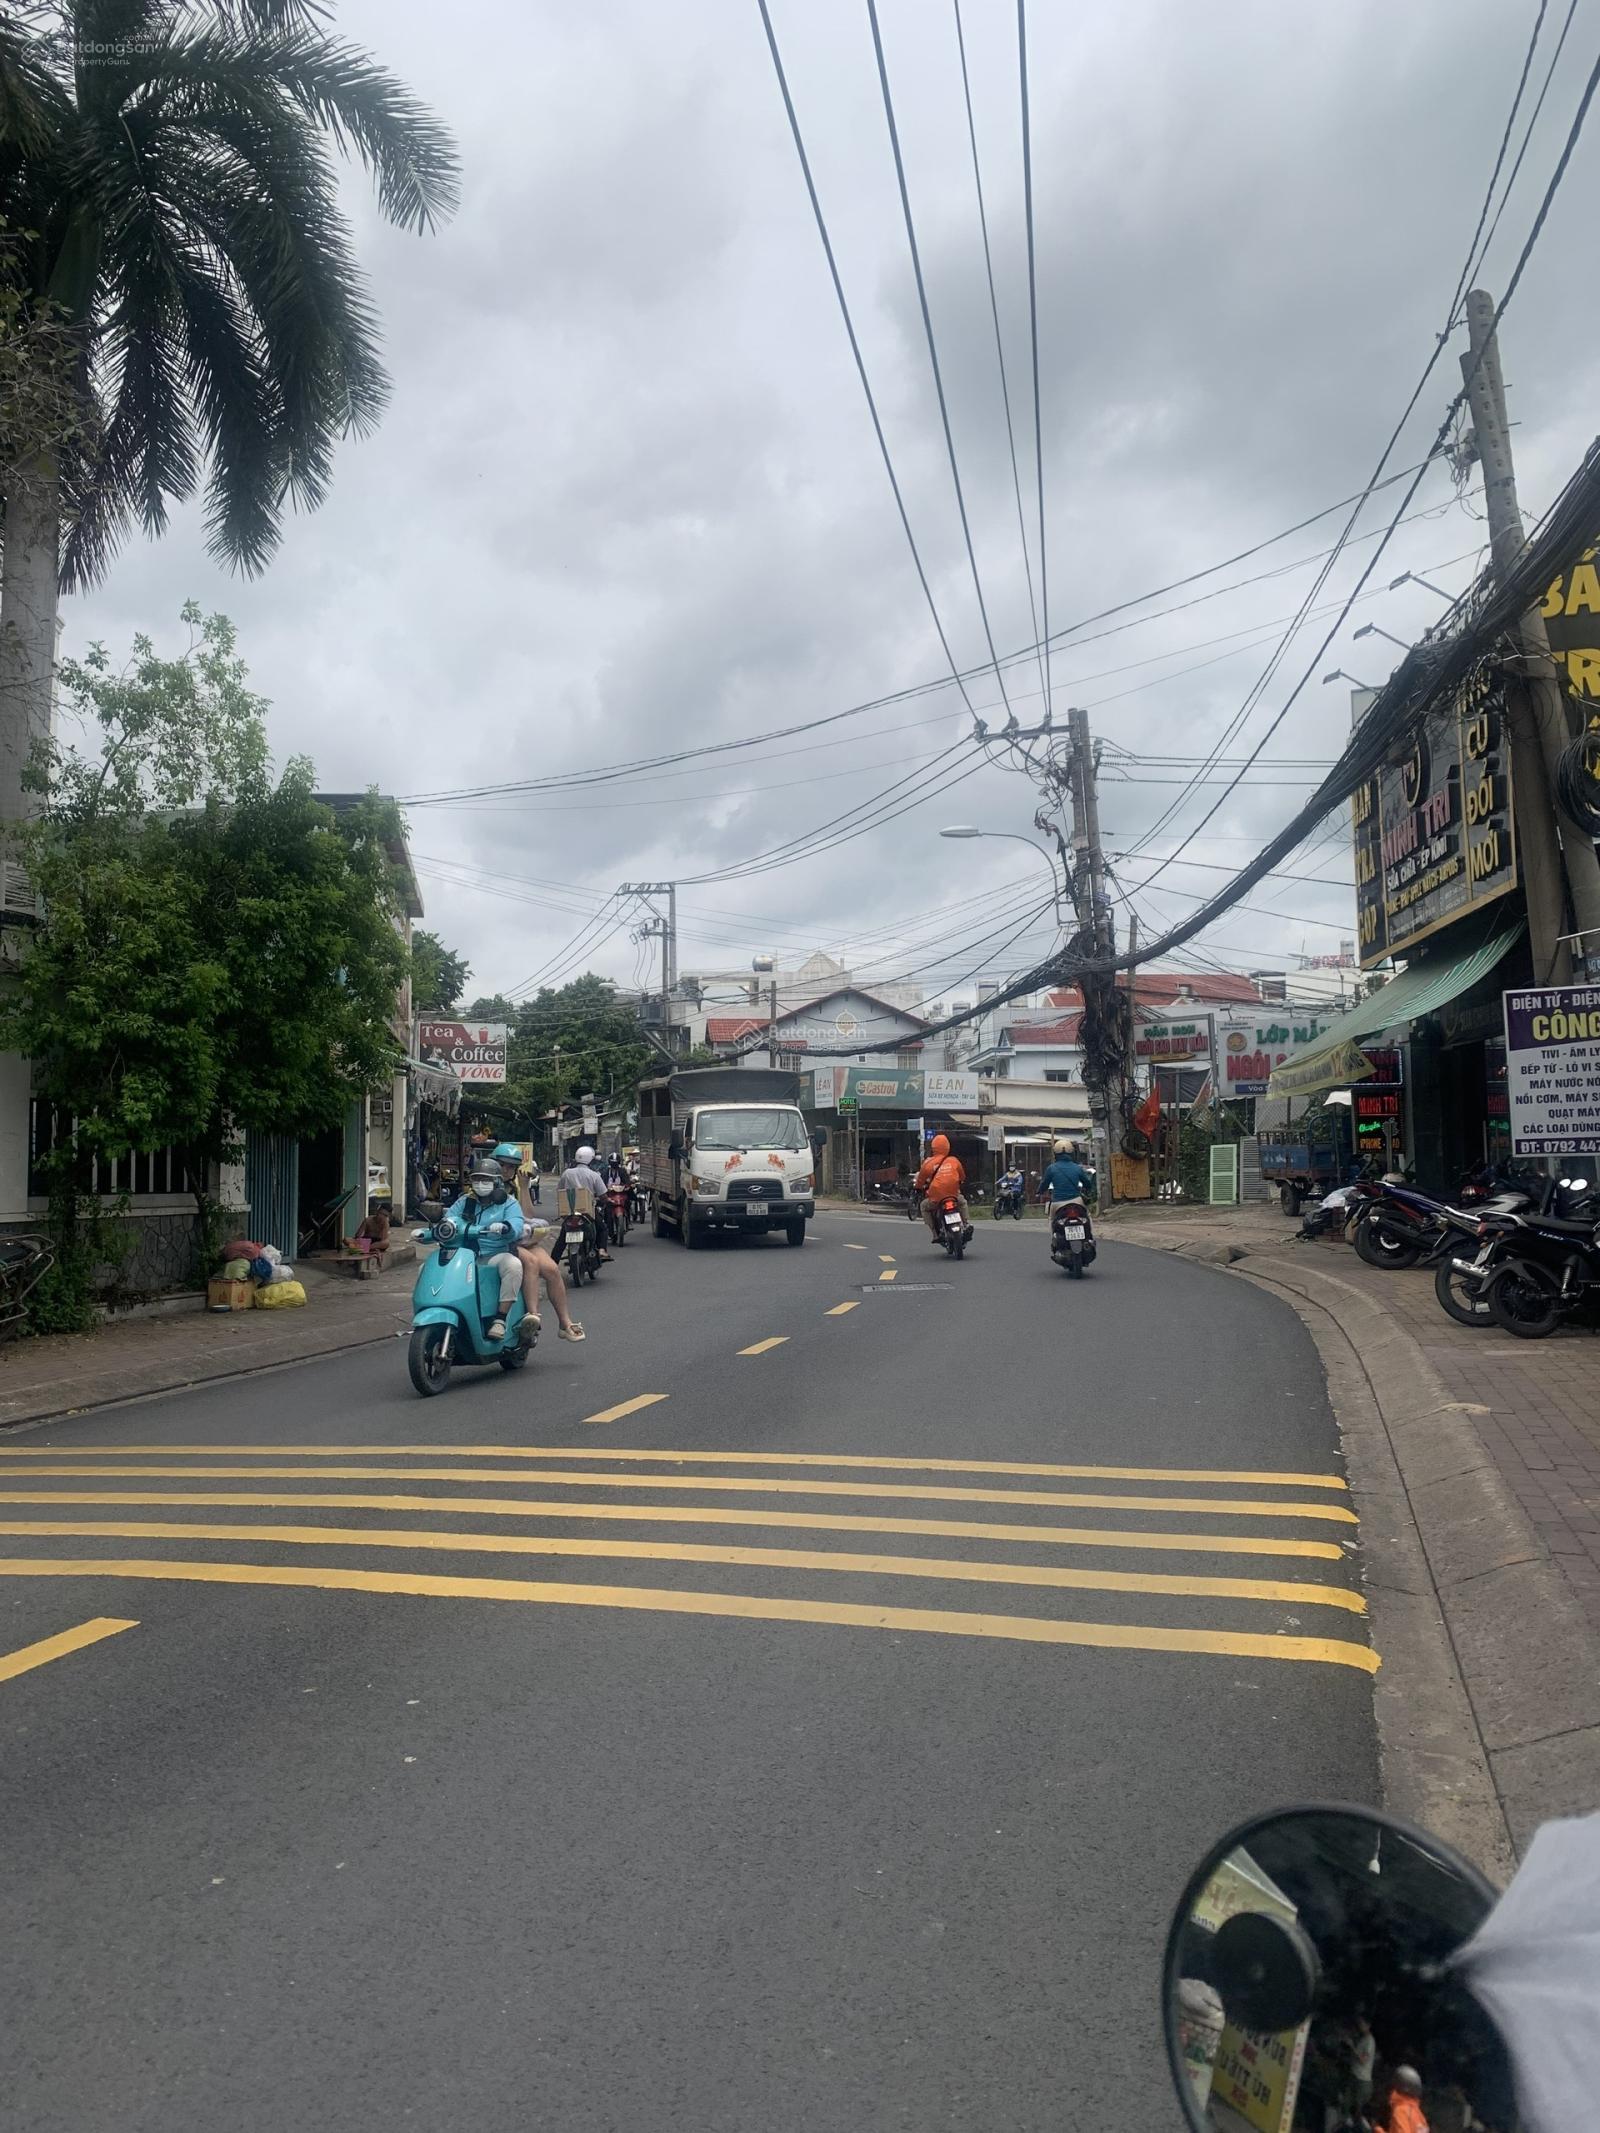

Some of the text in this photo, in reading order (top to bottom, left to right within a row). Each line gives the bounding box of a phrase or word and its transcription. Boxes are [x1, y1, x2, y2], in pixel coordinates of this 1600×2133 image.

[1512, 996, 1542, 1013] ĐIỆN
[421, 1025, 454, 1038] Tea
[1532, 1008, 1600, 1042] CÔNG
[1256, 1023, 1290, 1045] LỚP
[454, 1037, 465, 1046] &
[450, 1046, 504, 1062] Coffee
[1541, 1049, 1560, 1060] TIVI
[1226, 1049, 1271, 1081] NGÔI
[1520, 1063, 1540, 1075] BẾP
[866, 1081, 897, 1096] Castrol
[945, 1078, 965, 1091] AN
[1529, 1078, 1551, 1090] MÁY
[1555, 1076, 1584, 1089] NƯỚC
[1565, 1090, 1589, 1103] MÁY
[1548, 1108, 1575, 1120] QUẠT
[1523, 1122, 1544, 1134] CÁC
[1546, 1123, 1570, 1135] LOẠI
[1543, 1140, 1576, 1154] 0792
